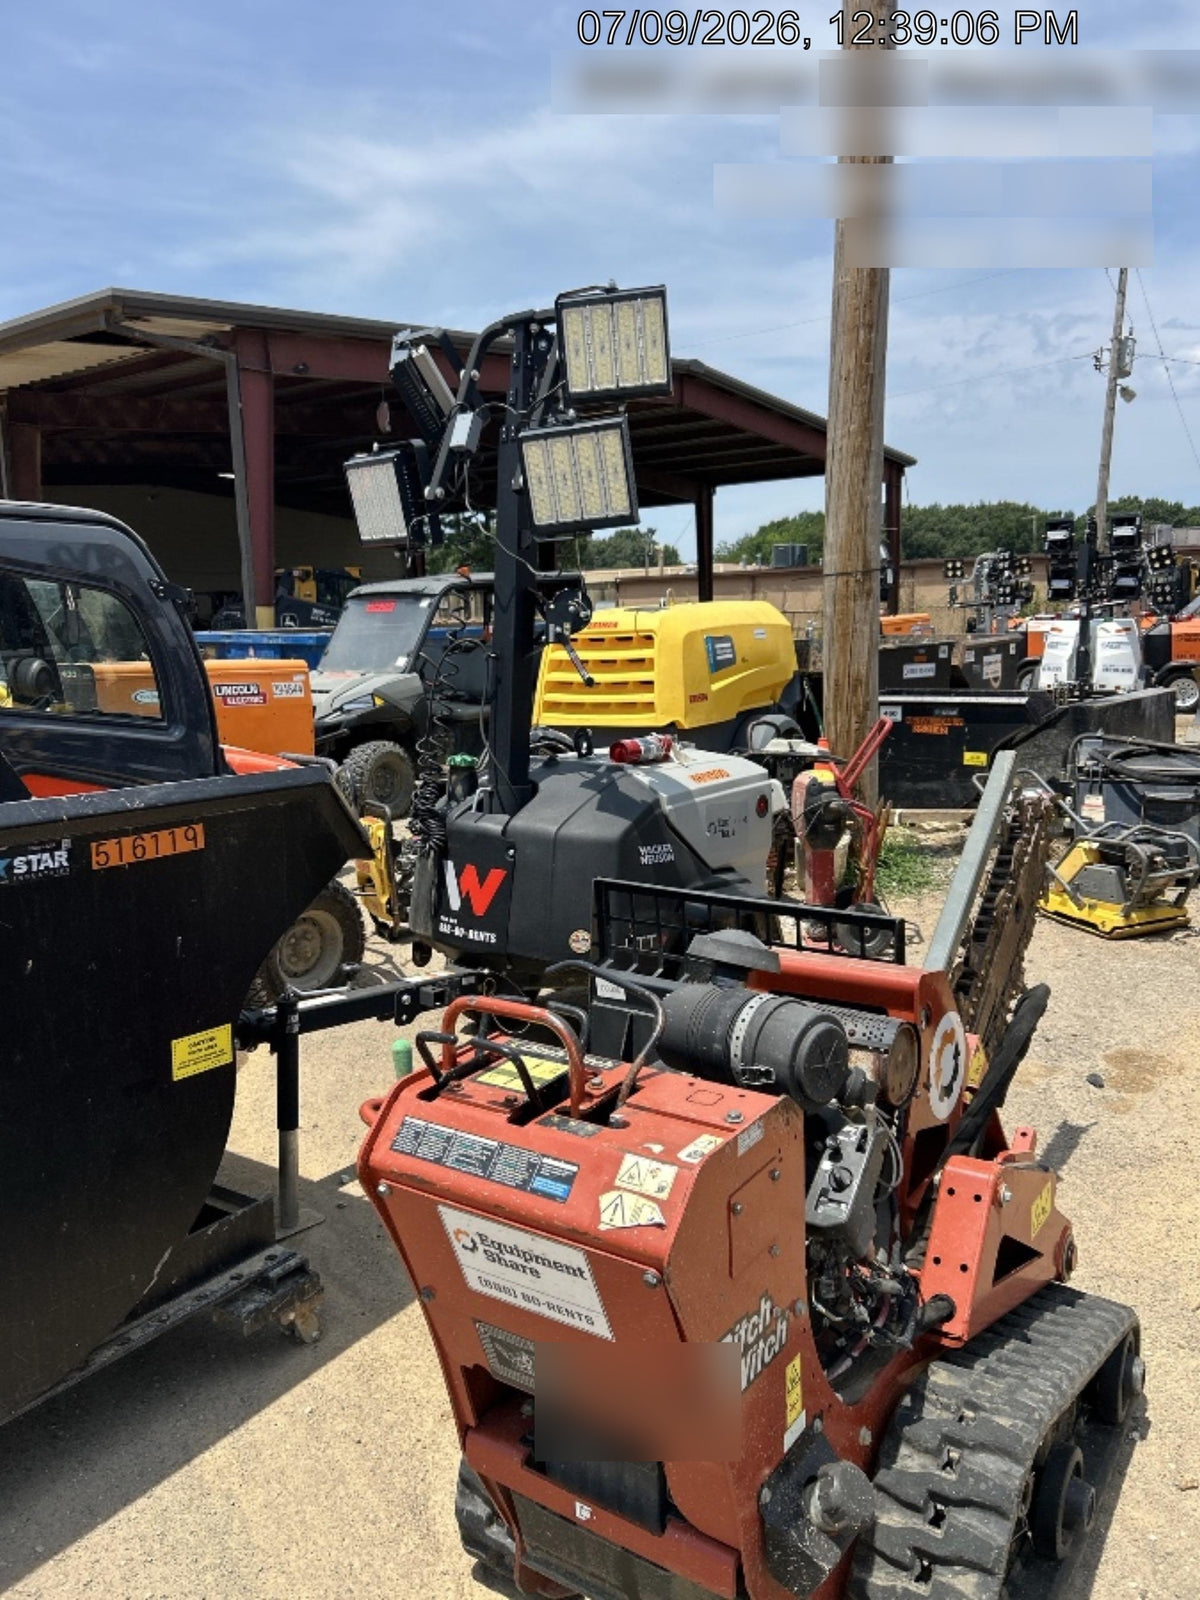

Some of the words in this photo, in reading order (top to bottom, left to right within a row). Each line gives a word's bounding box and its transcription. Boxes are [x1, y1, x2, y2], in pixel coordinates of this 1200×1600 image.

[215, 684, 258, 696] LINCOLN
[13, 850, 70, 874] STAR
[95, 826, 198, 867] 516119
[476, 1231, 588, 1281] Equipment
[482, 1249, 542, 1280] Share
